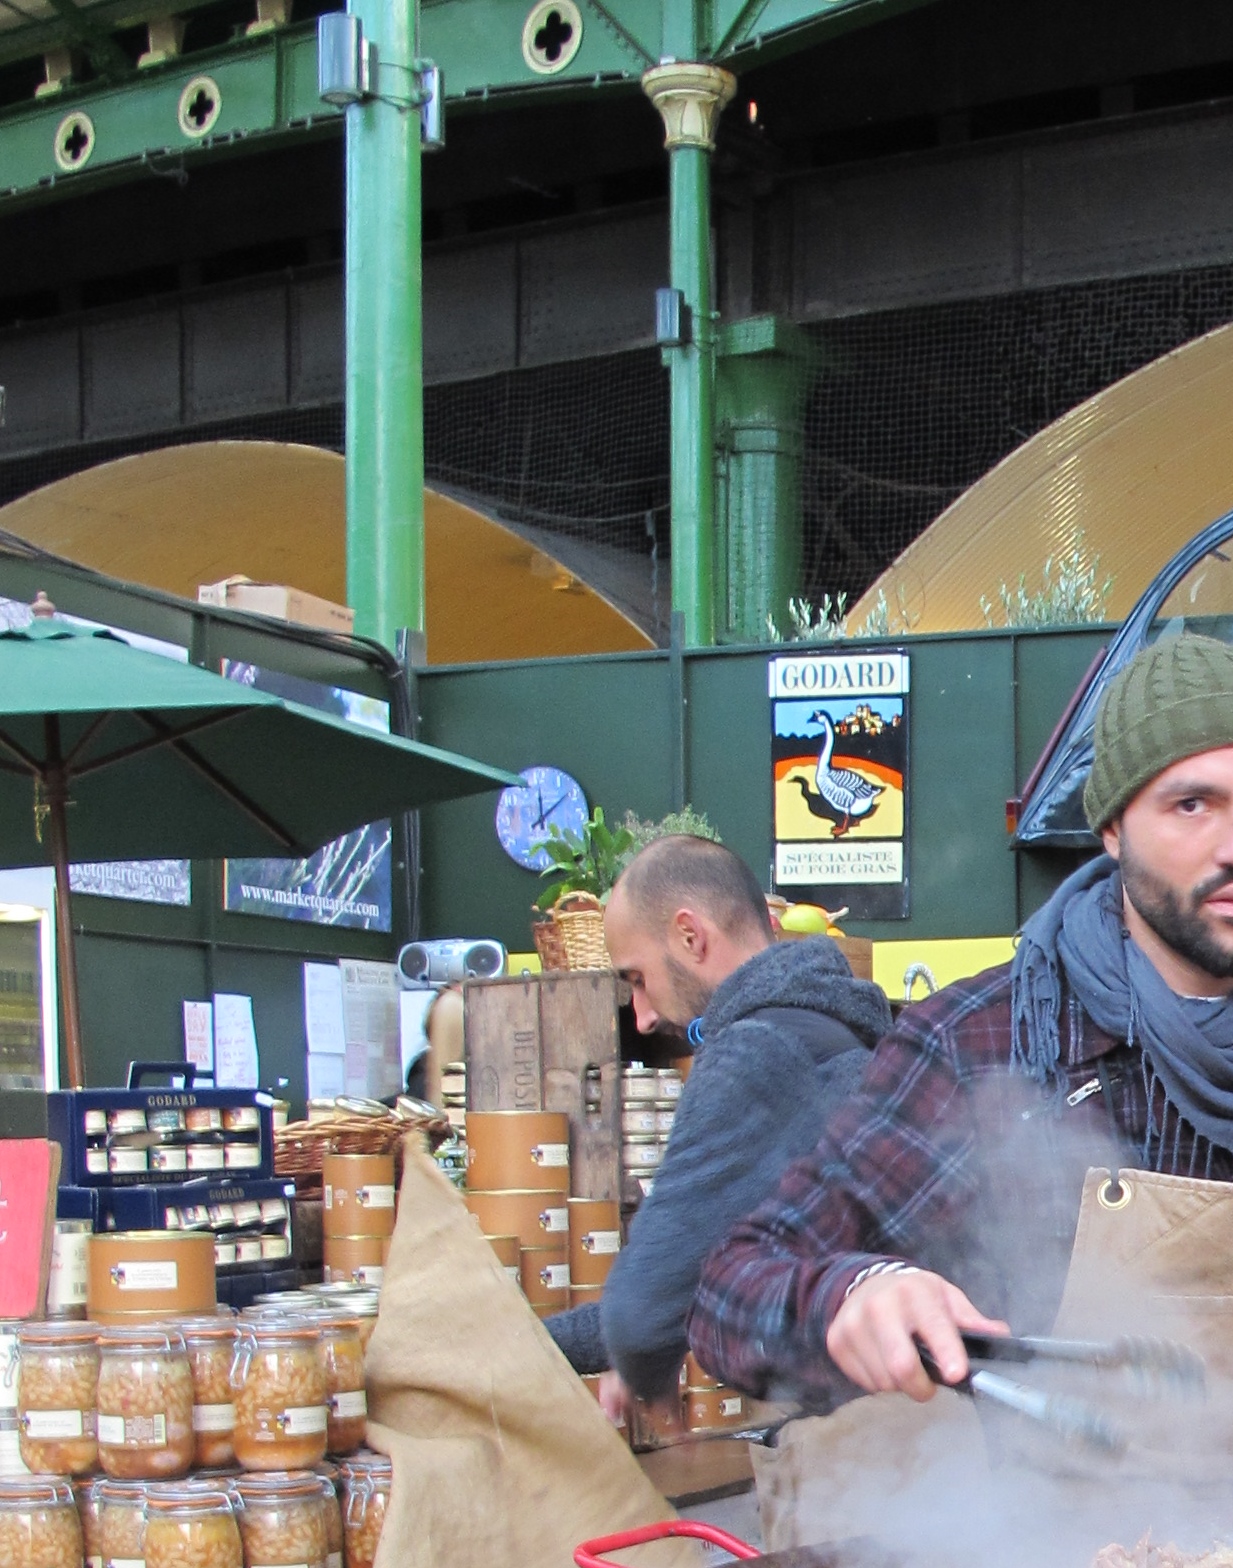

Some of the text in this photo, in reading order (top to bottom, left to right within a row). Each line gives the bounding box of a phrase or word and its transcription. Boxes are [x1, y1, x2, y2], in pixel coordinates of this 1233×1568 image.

[781, 661, 895, 690] GODARD
[782, 863, 898, 876] DU FOIE GRAS
[240, 883, 380, 918] www.marketquarter.com
[147, 1094, 198, 1107] GODARD
[208, 1186, 246, 1200] GODARD
